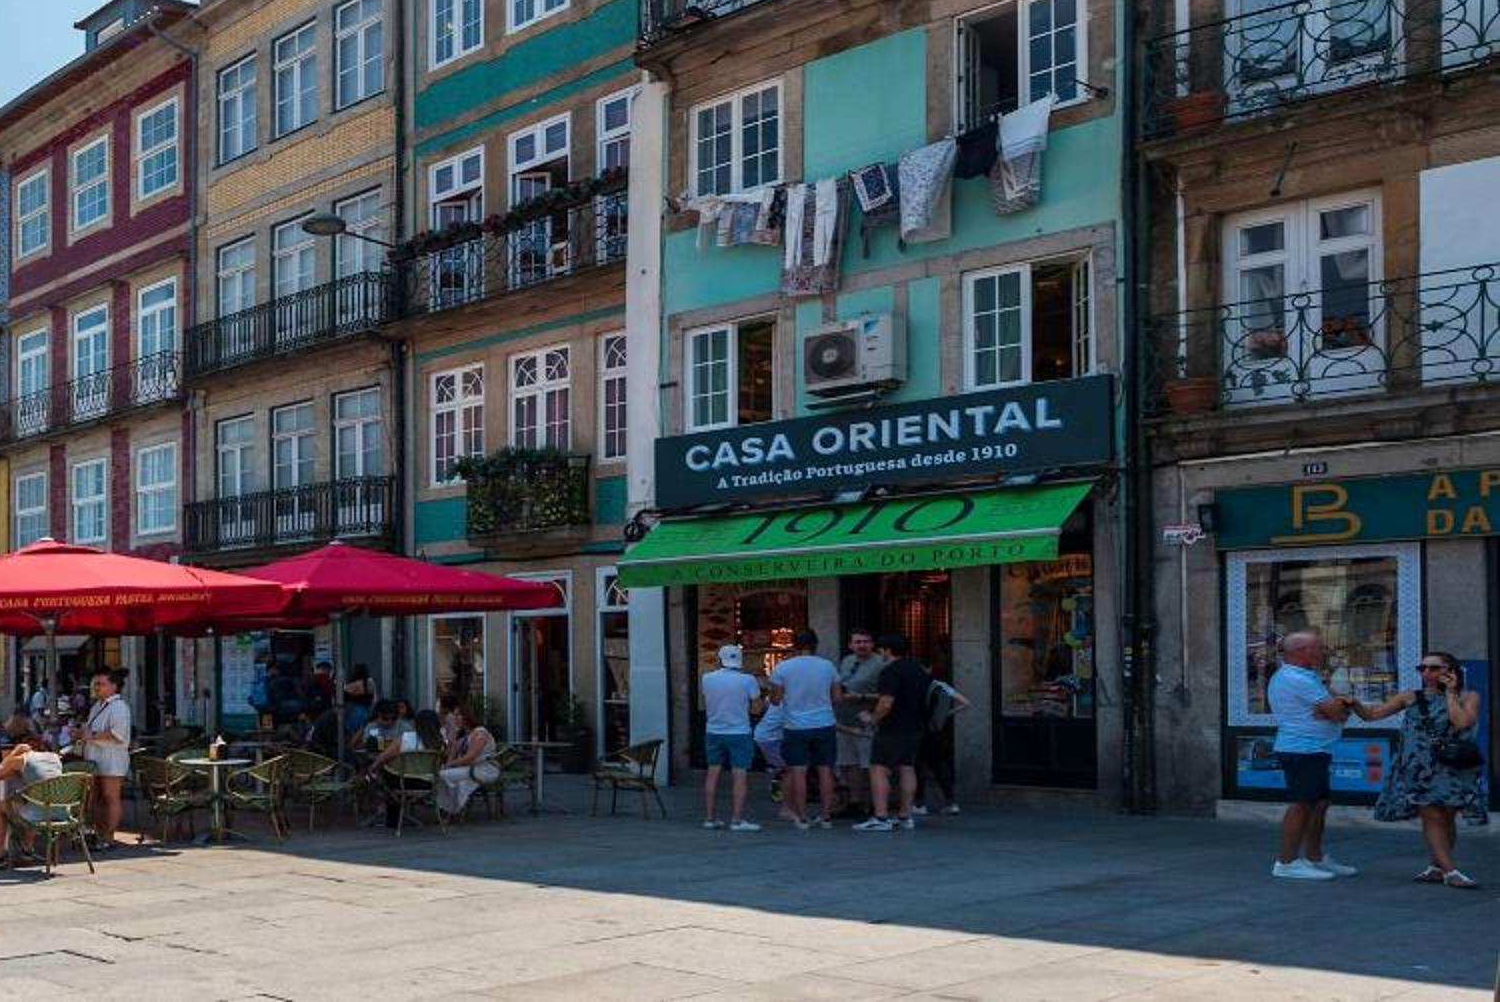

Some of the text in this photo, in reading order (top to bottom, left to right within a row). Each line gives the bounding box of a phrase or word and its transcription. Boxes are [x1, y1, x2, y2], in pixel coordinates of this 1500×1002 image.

[685, 398, 1062, 471] CASA ORIENTAL
[716, 444, 1018, 489] A Tradição Portuguesa desde 1910
[1428, 476, 1456, 499] A
[742, 498, 975, 544] 1910
[1427, 506, 1492, 535] DA
[880, 554, 915, 568] DO
[932, 544, 1025, 563] PORTO
